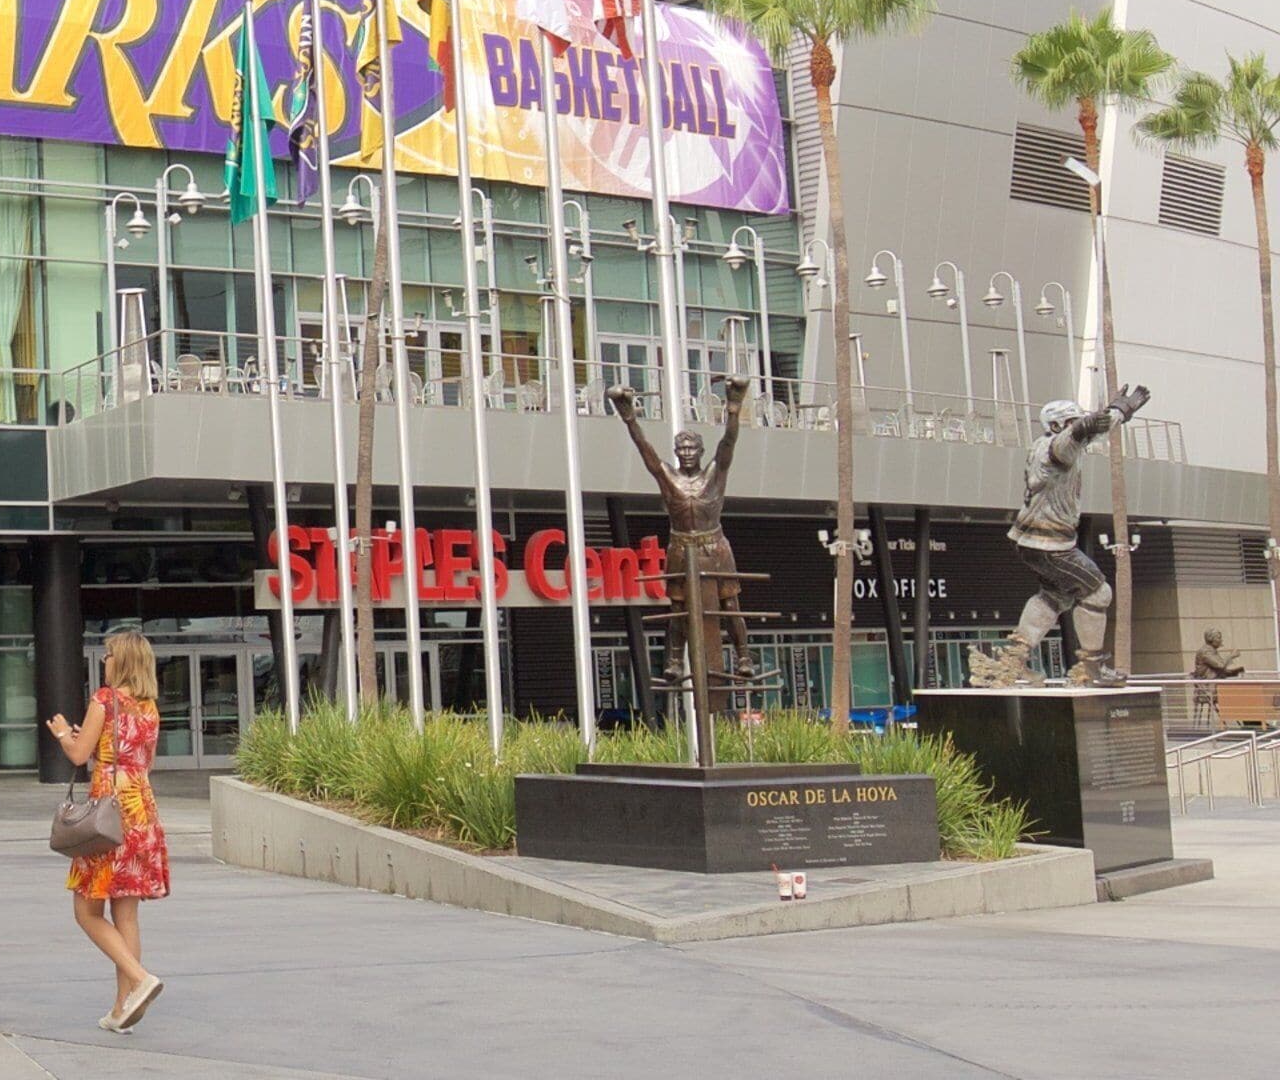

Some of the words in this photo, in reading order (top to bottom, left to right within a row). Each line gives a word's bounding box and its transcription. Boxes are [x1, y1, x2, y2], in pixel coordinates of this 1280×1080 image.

[525, 528, 668, 602] Cent
[853, 577, 878, 599] OX
[746, 788, 800, 808] OSCAR
[804, 788, 827, 805] DE
[831, 787, 852, 804] LA
[856, 785, 898, 803] HOYA
